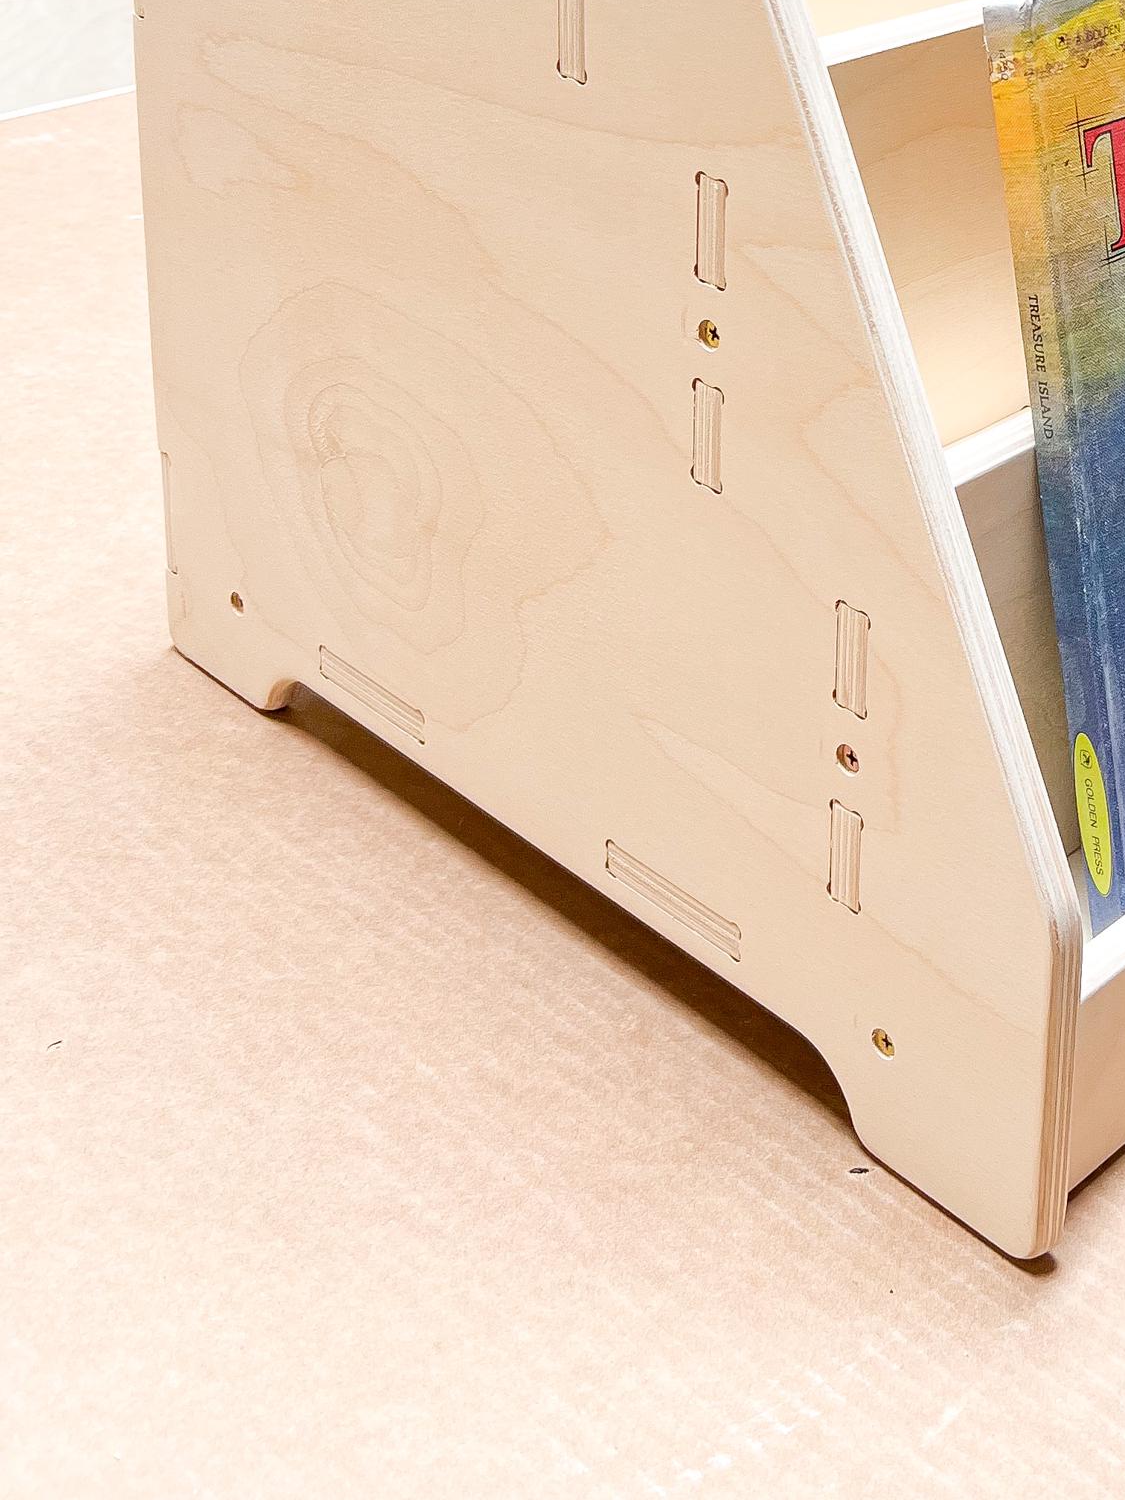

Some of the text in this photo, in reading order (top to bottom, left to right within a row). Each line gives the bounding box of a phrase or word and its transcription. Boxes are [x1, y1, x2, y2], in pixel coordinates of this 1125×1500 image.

[1028, 294, 1054, 439] TREASURE ISLAND
[1084, 778, 1104, 876] GOLDEN PRESS
